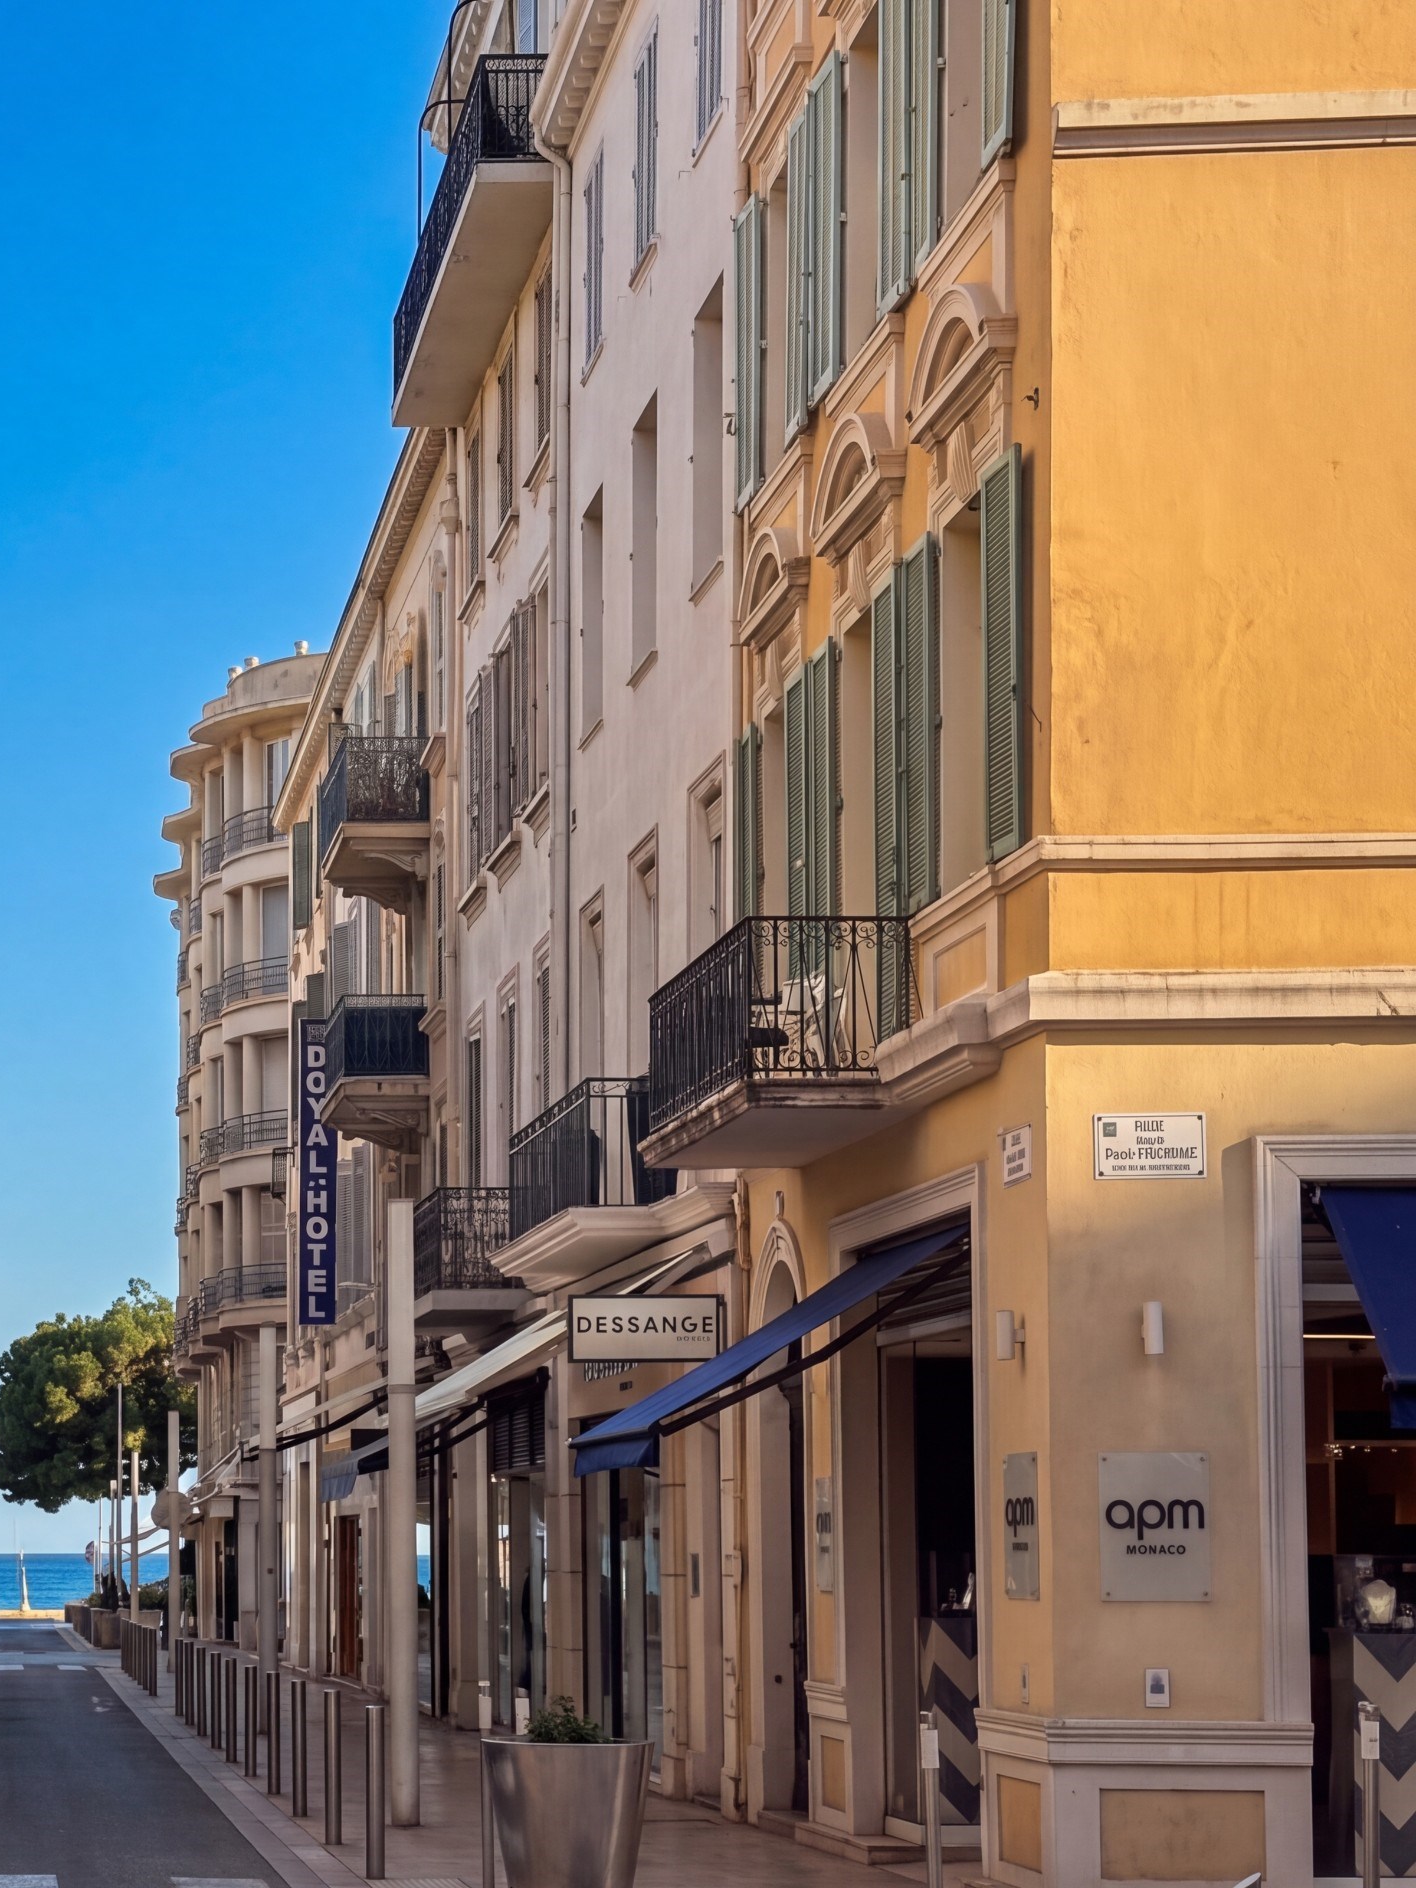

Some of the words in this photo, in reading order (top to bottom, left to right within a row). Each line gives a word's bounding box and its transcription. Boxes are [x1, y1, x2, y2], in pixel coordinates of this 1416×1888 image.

[305, 1189, 329, 1318] HOTEL
[577, 1316, 714, 1334] DESSANGE
[1005, 1497, 1034, 1538] apm
[1105, 1499, 1205, 1541] apm
[1126, 1544, 1186, 1555] MONACO
